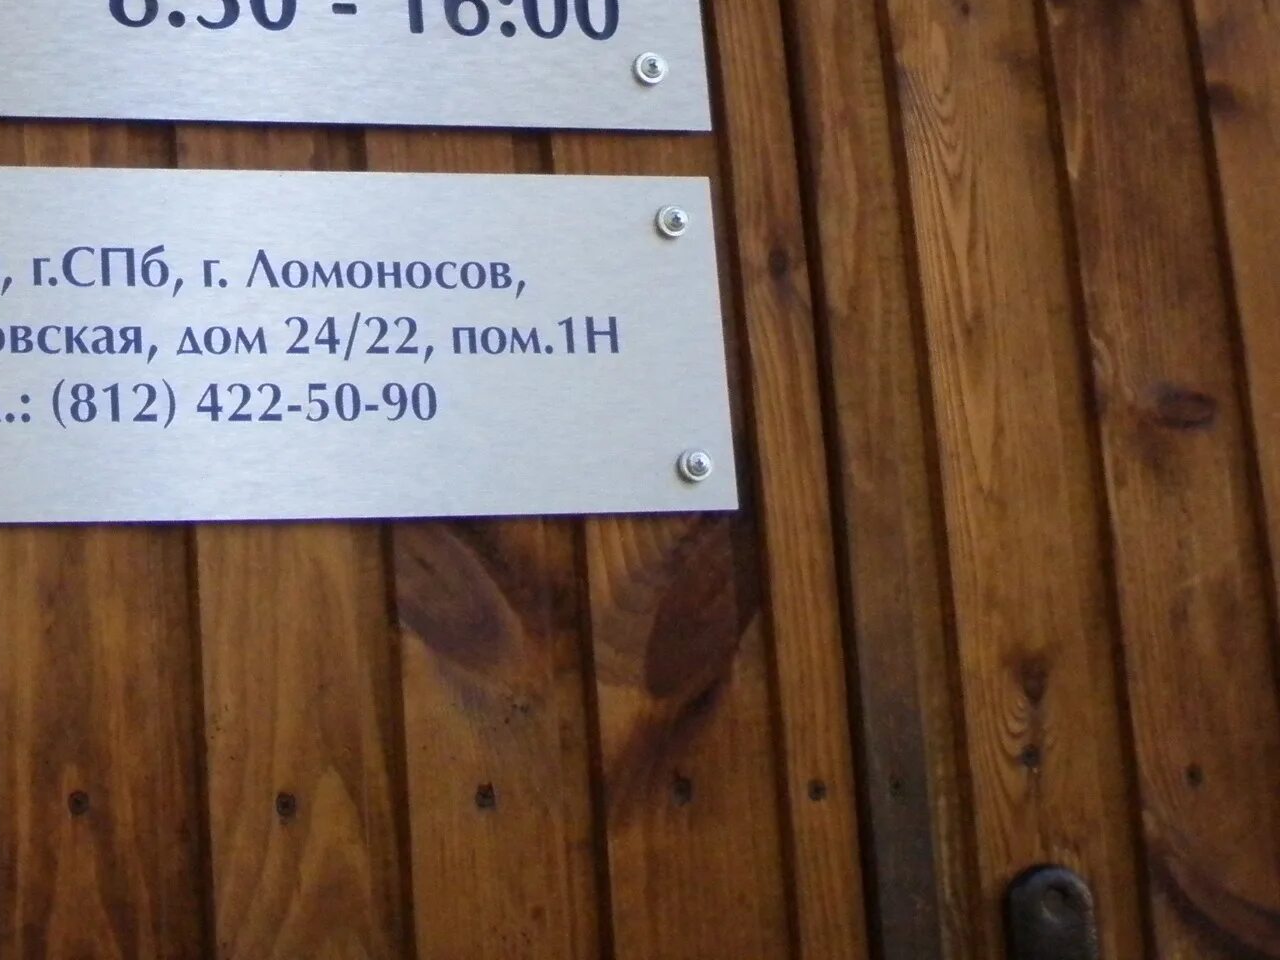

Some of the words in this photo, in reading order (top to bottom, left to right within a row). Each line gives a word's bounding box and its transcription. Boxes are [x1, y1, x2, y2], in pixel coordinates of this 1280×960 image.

[331, 2, 359, 17] -
[32, 244, 184, 298] г.СПб,
[202, 259, 228, 289] г.
[245, 248, 527, 300] Ломоносов,
[176, 326, 268, 364] дом
[284, 311, 434, 364] 24/22,
[452, 315, 620, 356] пом.1Н
[52, 378, 177, 430] (812)
[196, 382, 438, 423] 422-50-90
